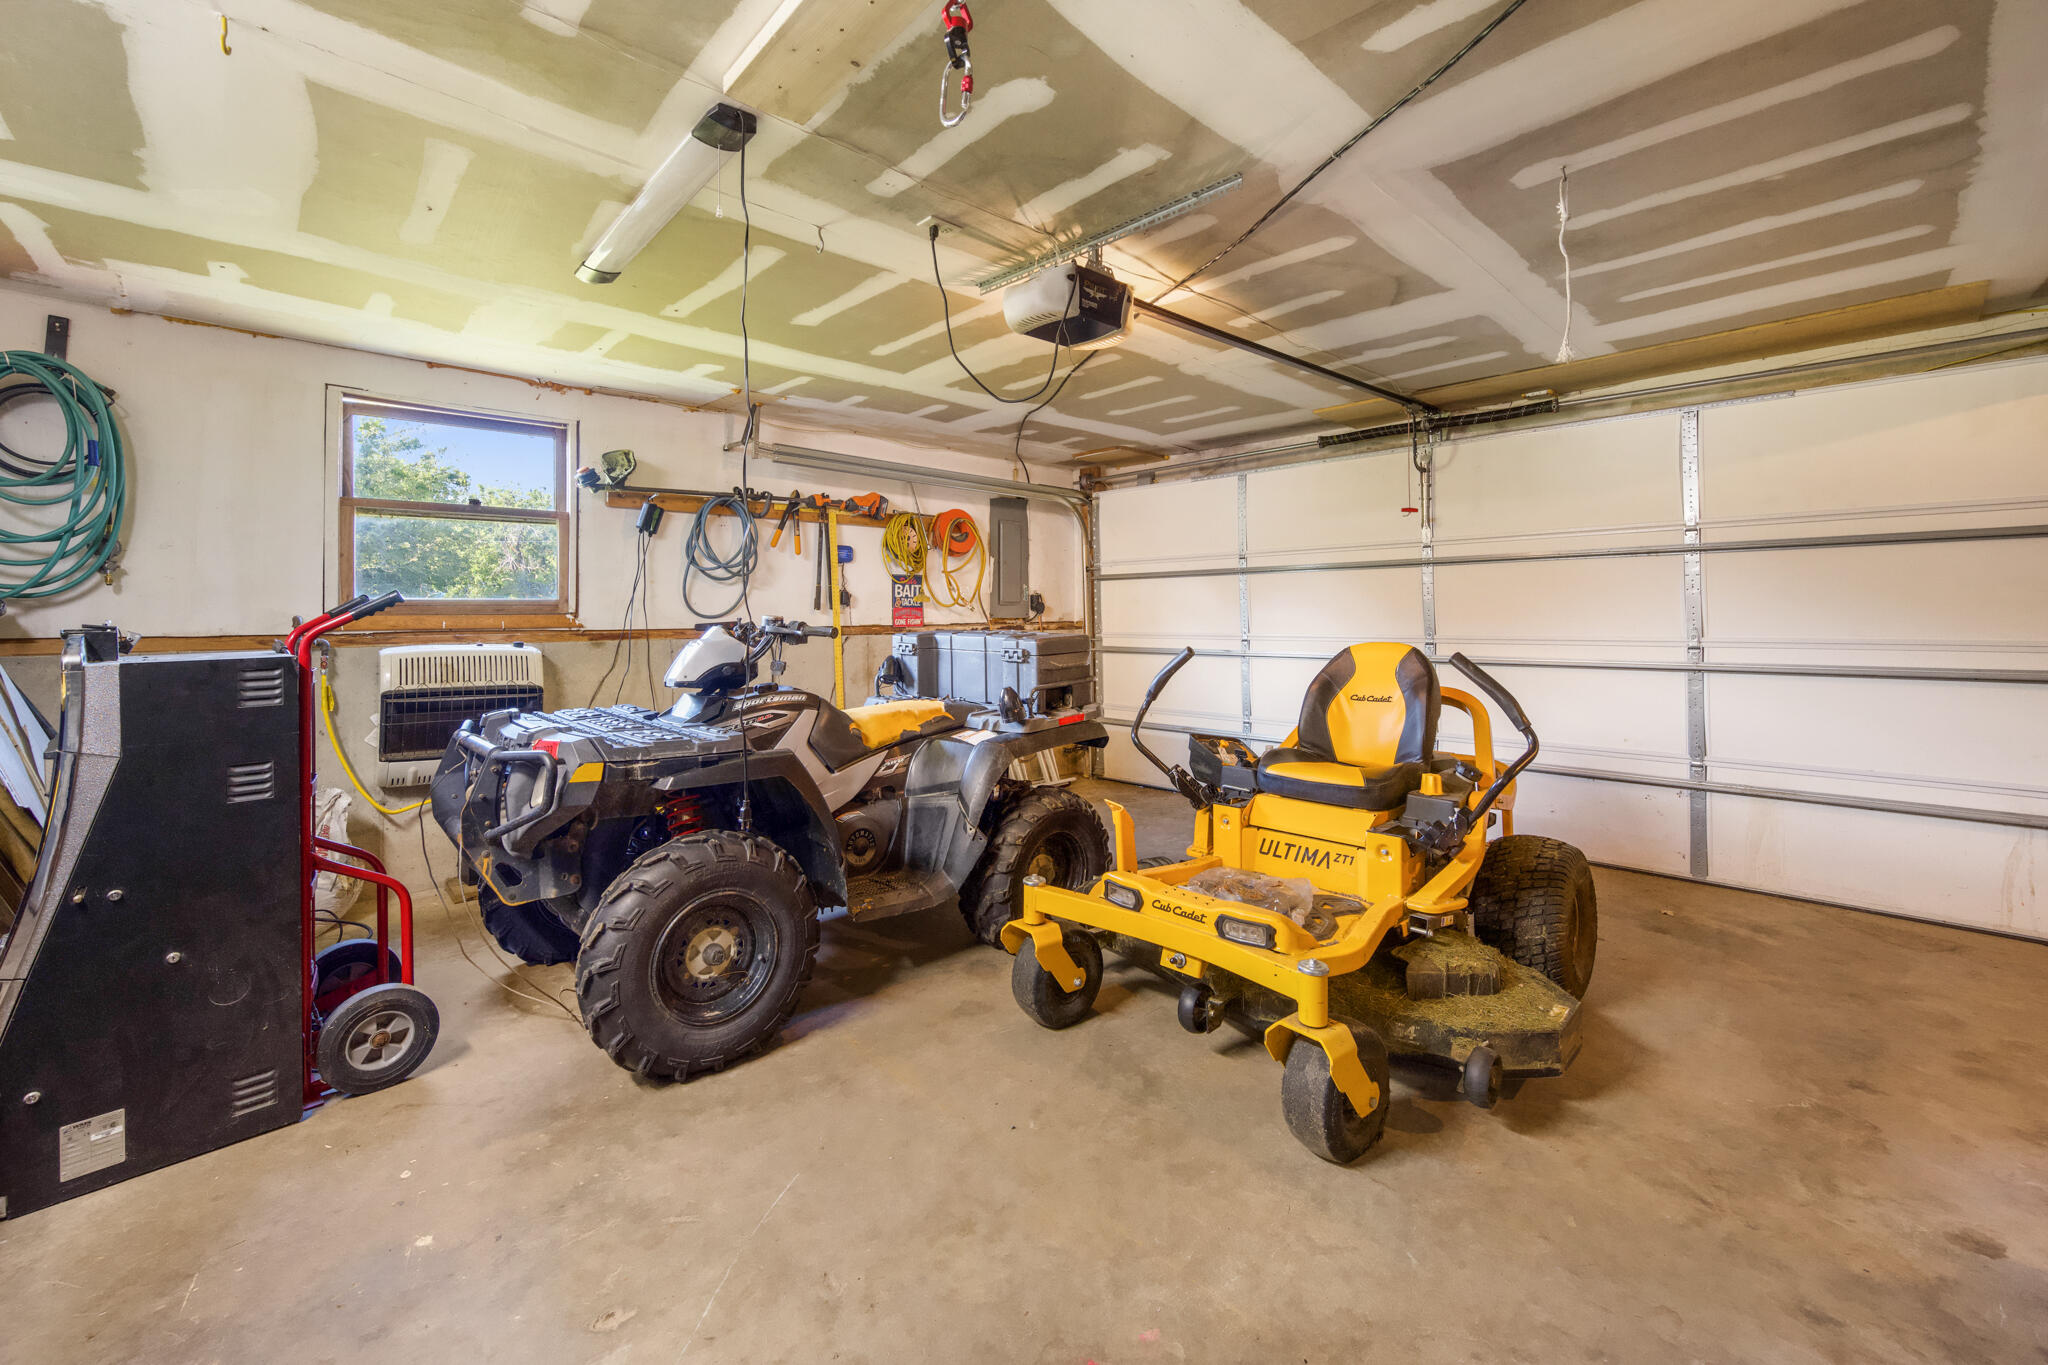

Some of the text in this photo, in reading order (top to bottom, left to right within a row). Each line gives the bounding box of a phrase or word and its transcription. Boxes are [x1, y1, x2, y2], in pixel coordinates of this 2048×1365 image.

[895, 584, 921, 597] BAIT
[1350, 694, 1392, 703] Cub Cadet
[1259, 838, 1355, 869] ULTIMA ZT1
[1151, 899, 1208, 924] Cub Cadet
